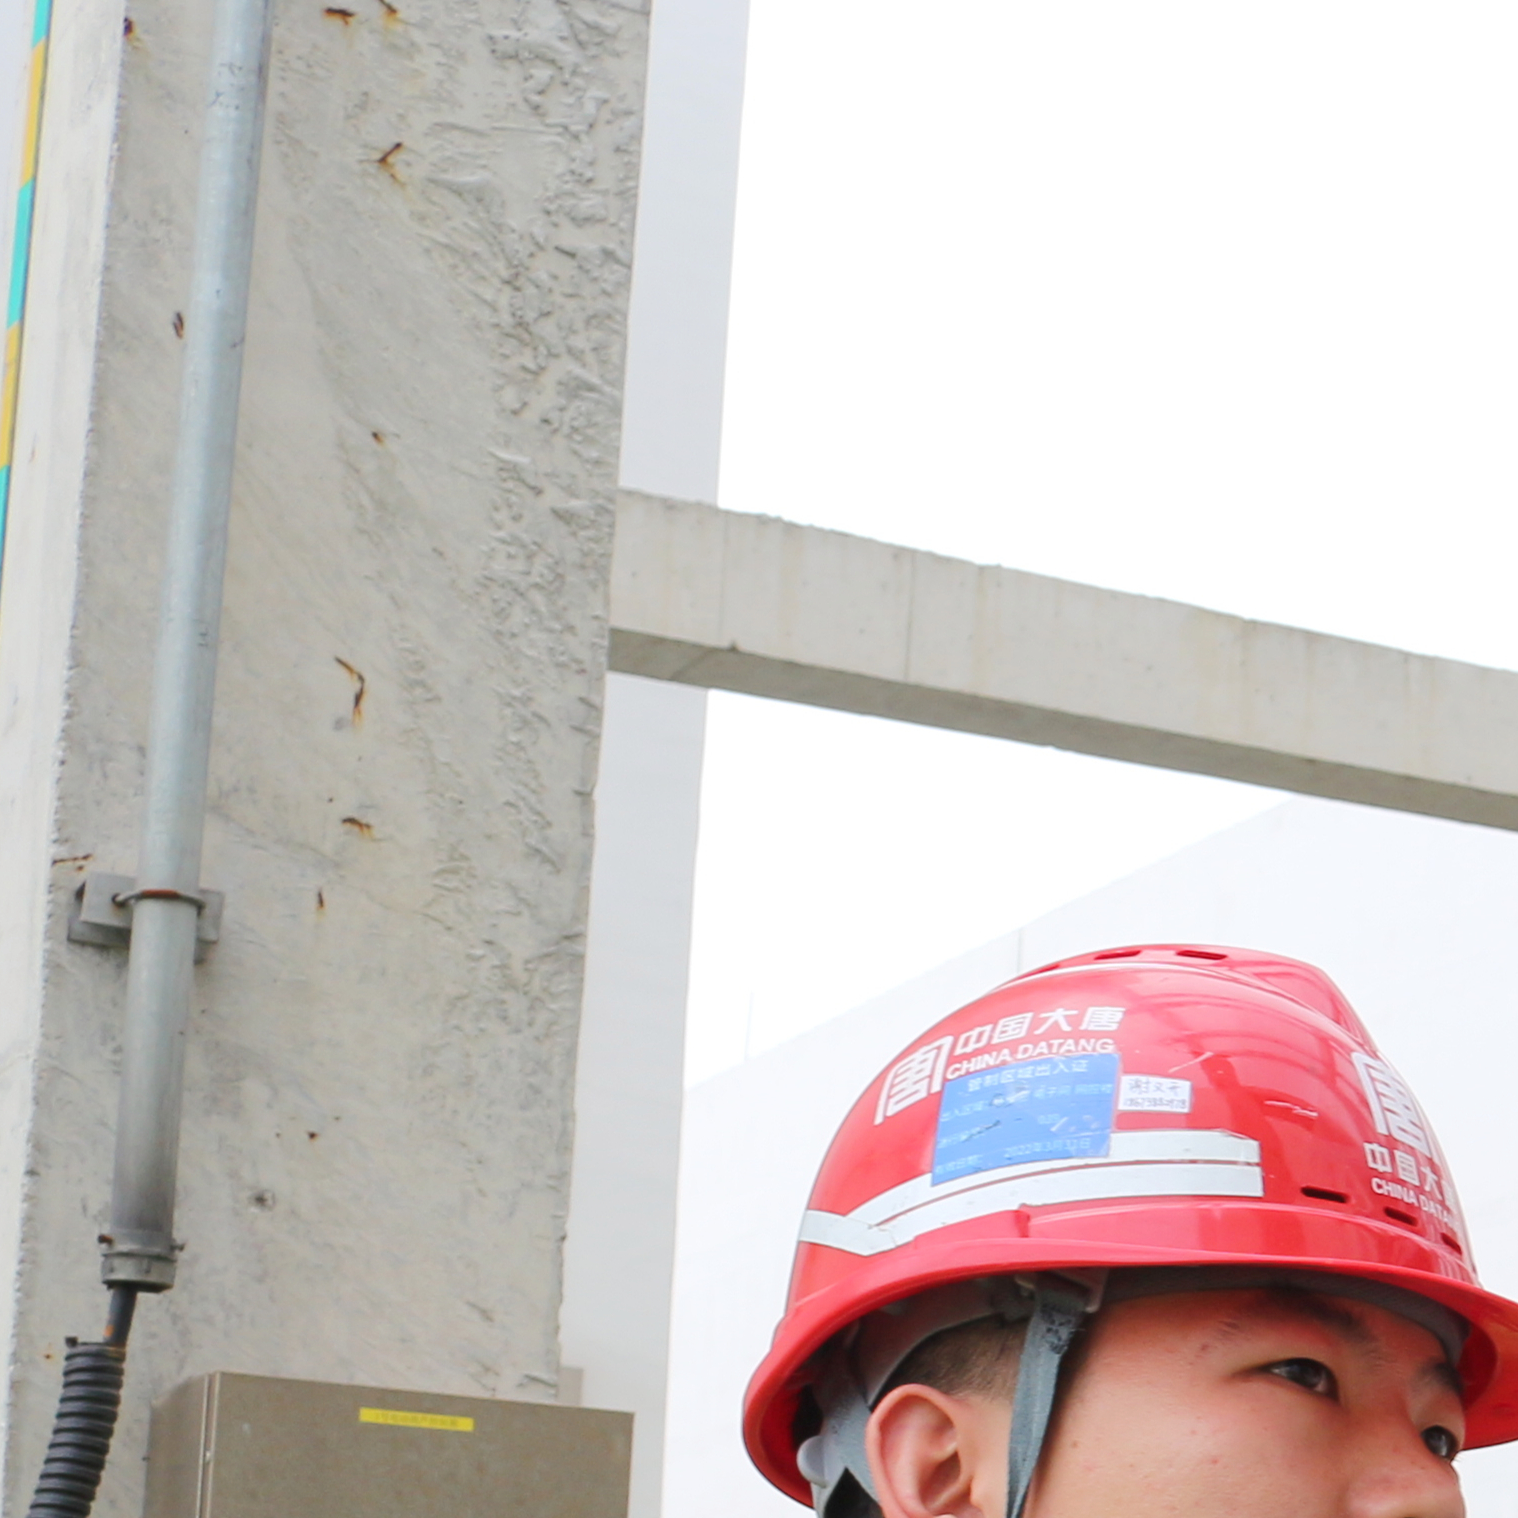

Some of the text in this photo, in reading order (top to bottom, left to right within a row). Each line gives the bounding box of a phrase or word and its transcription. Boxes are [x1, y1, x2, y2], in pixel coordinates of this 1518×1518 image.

[953, 1006, 1126, 1056] 中国大唐
[946, 1038, 1115, 1080] CHINA DATANG
[1371, 1177, 1419, 1206] CHINA
